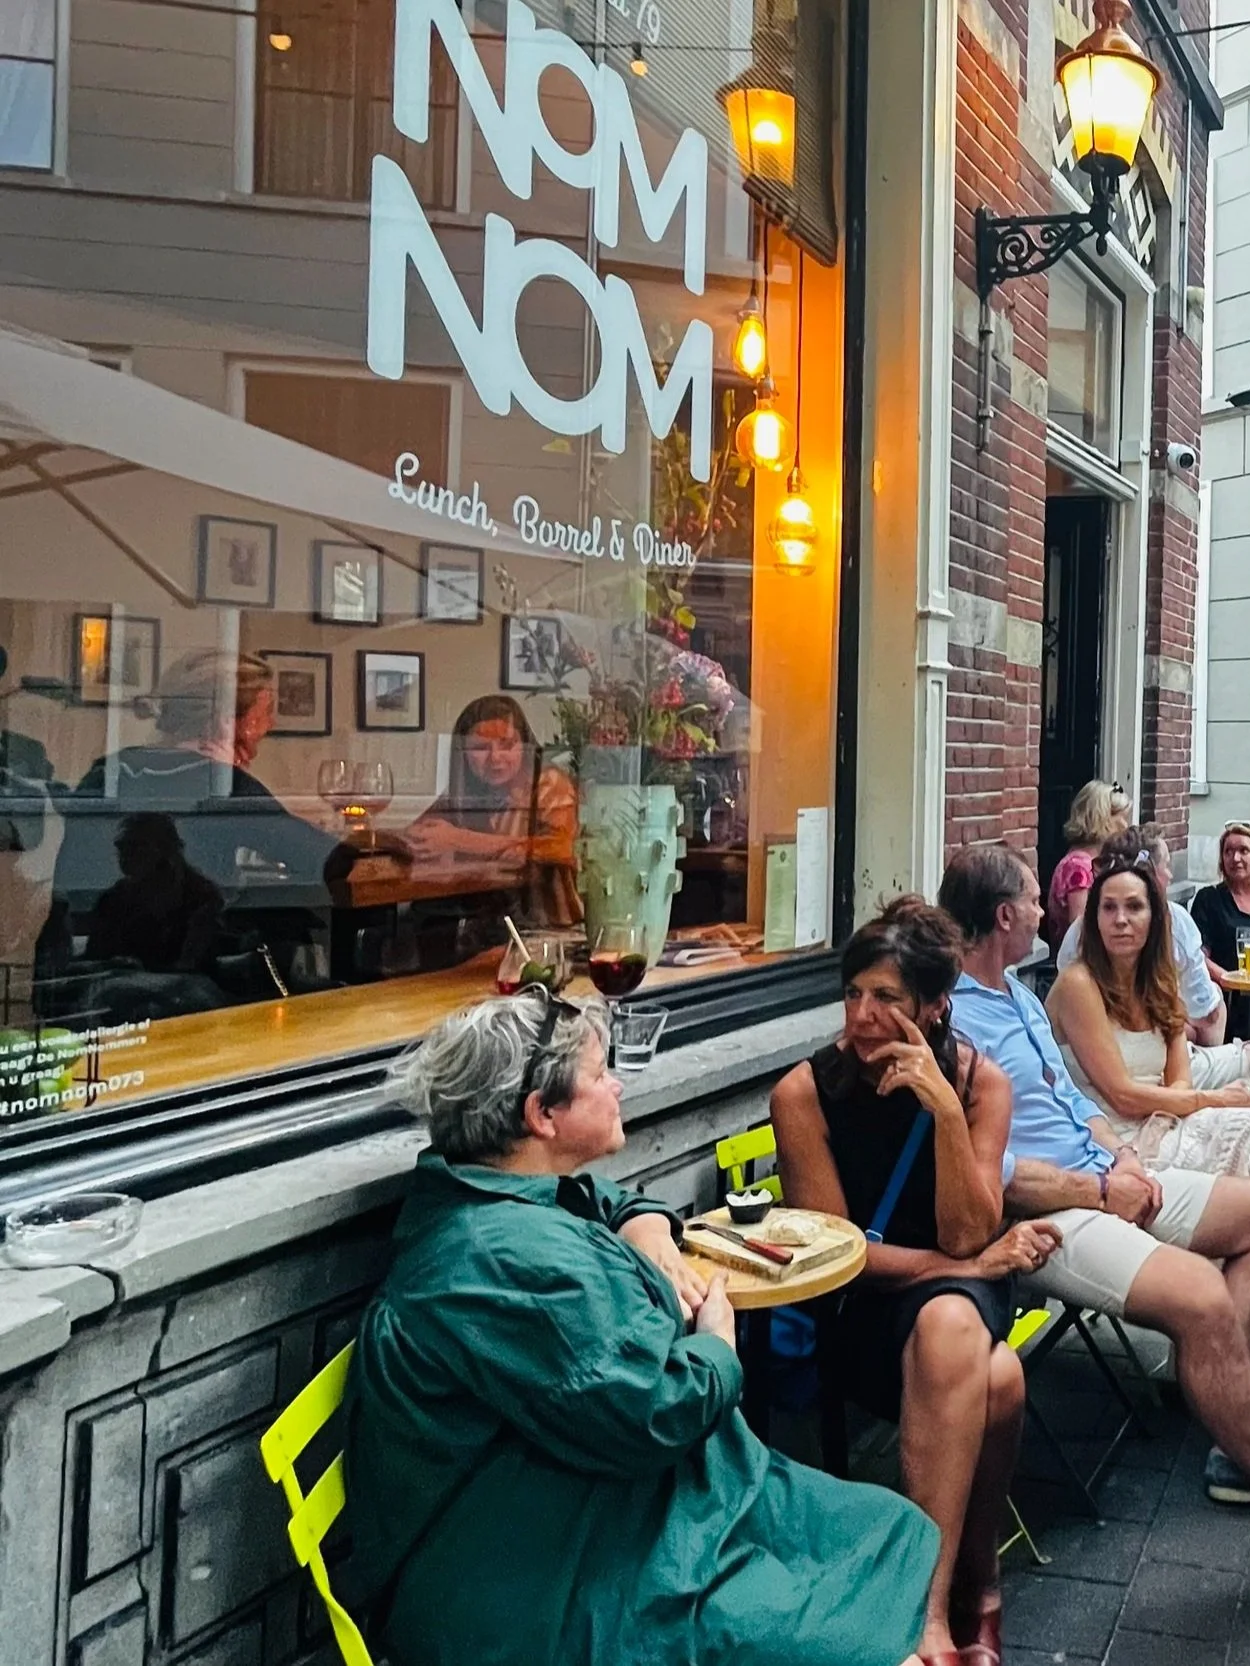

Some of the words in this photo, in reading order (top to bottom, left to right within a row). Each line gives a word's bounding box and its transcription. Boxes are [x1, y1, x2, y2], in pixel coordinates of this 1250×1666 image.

[393, 0, 708, 296] NOM
[367, 154, 714, 483] NOM
[388, 452, 498, 537] Lunch,
[513, 495, 604, 558] Borrel
[608, 520, 625, 561] &
